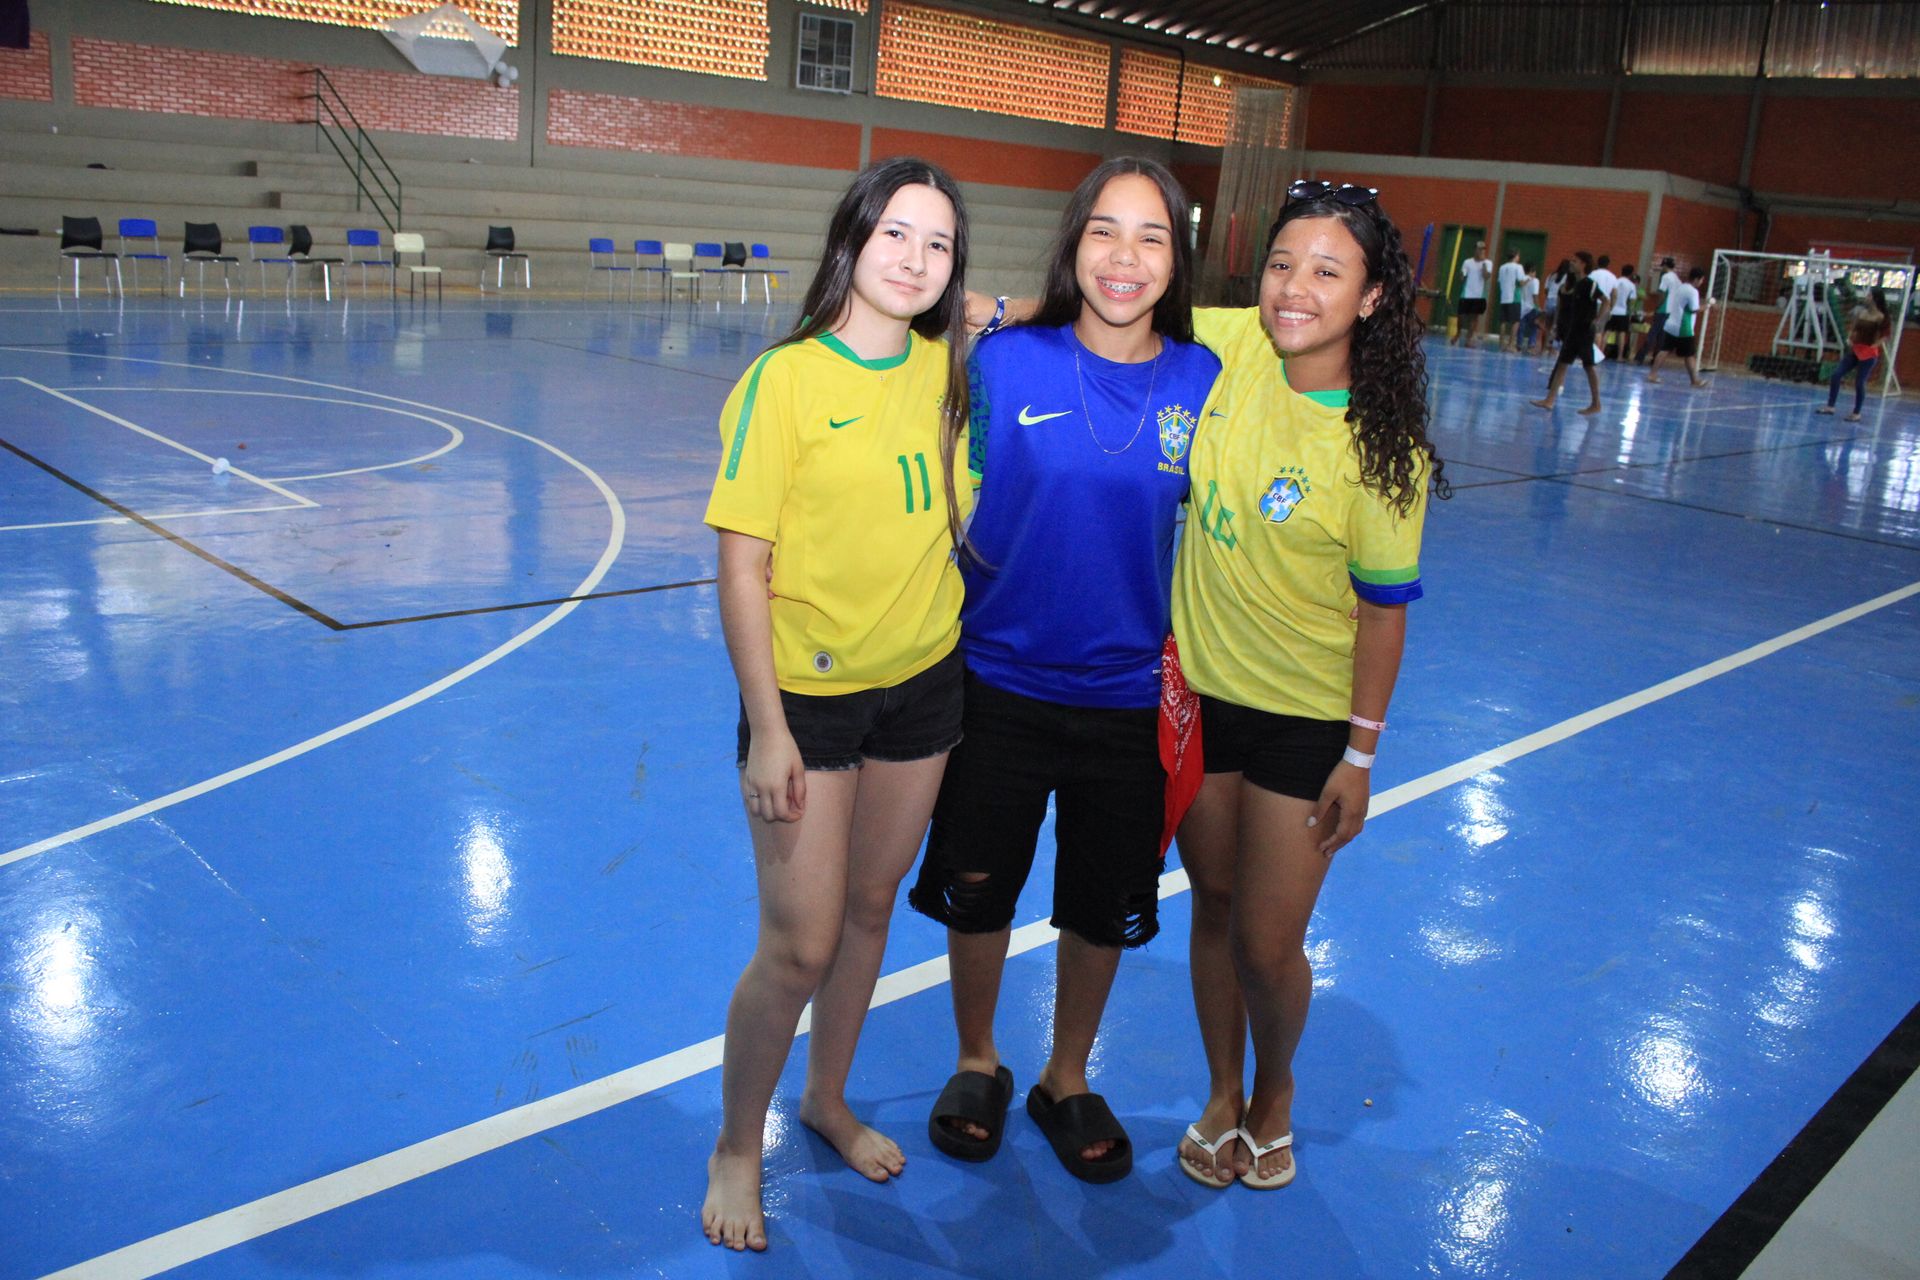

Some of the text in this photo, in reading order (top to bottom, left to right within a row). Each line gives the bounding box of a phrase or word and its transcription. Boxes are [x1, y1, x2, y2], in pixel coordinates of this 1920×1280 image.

[1157, 462, 1185, 475] BRASIL
[897, 452, 931, 513] 11
[1272, 492, 1287, 504] CBF
